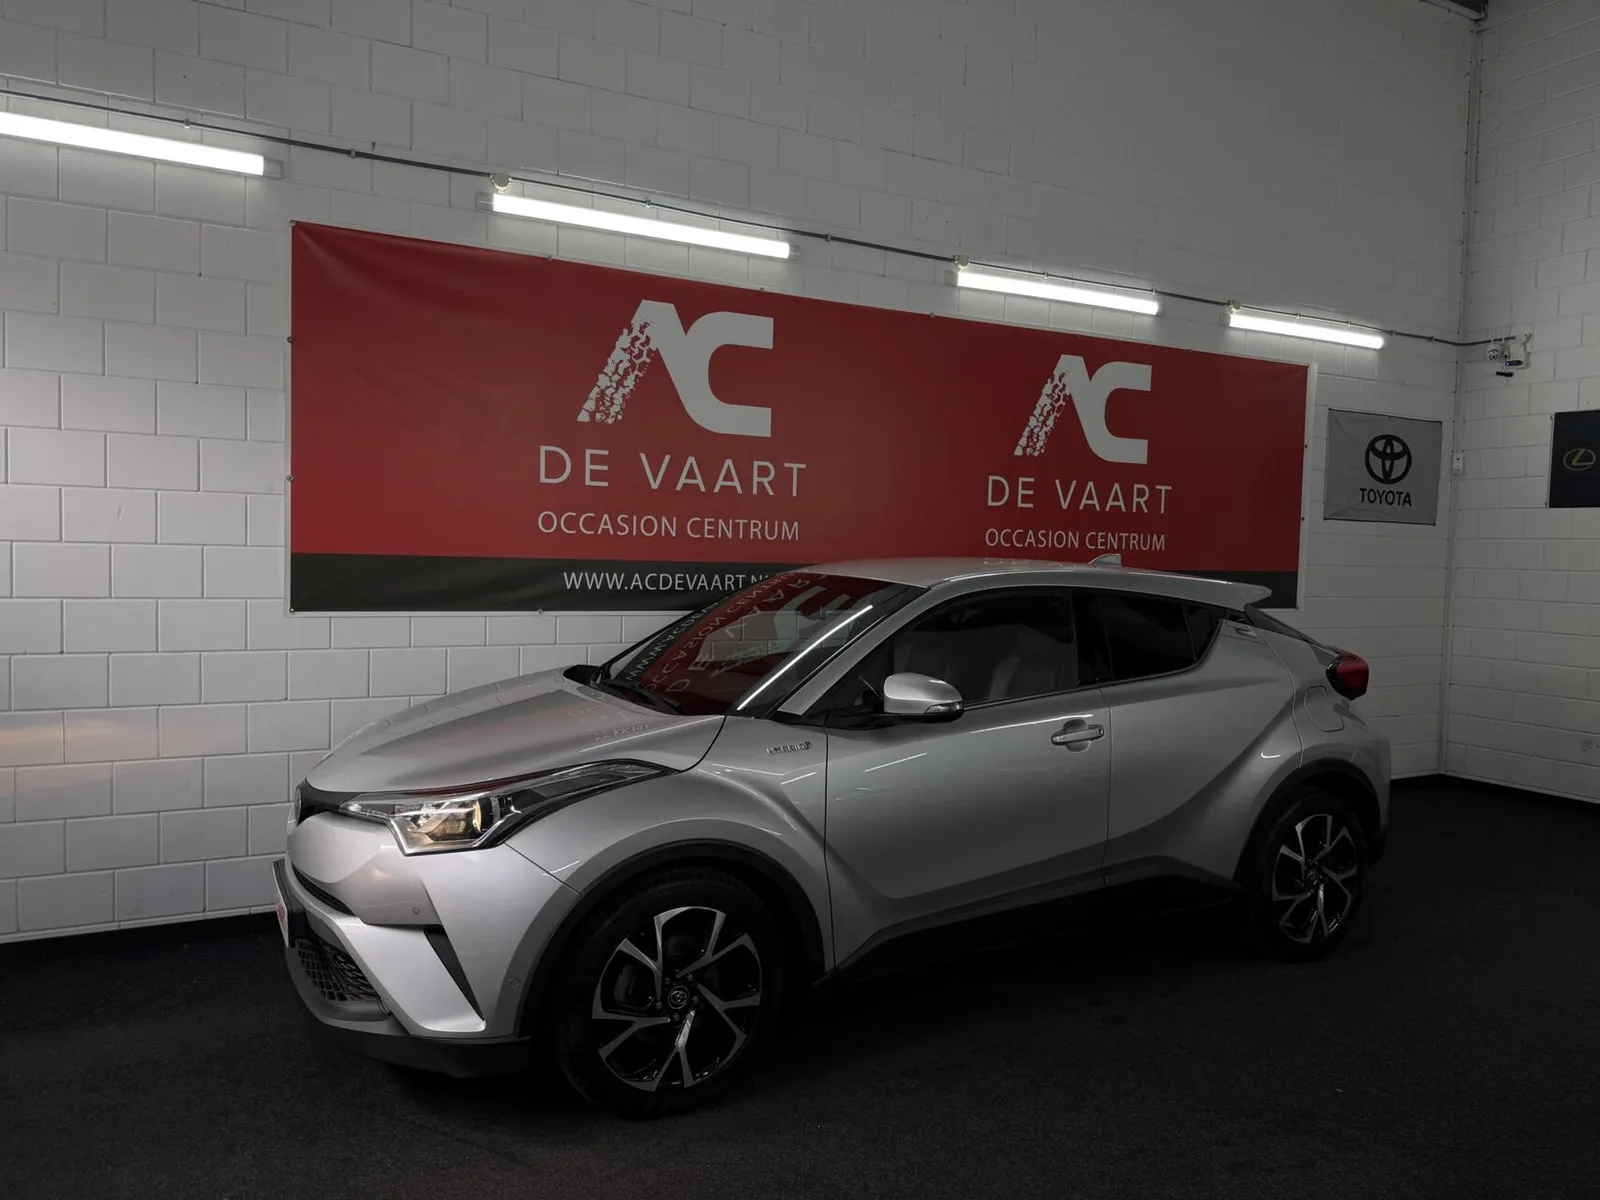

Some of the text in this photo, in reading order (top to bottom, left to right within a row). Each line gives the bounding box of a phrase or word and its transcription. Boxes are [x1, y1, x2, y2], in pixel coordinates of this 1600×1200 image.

[538, 444, 807, 497] DE VAART
[986, 474, 1173, 515] DE VAART
[1358, 487, 1413, 508] TOYOTA
[536, 510, 800, 541] OCCASION CENTRUM
[984, 527, 1166, 552] OCCASION CENTRUM
[562, 571, 769, 591] WWW.ACDEVAART
